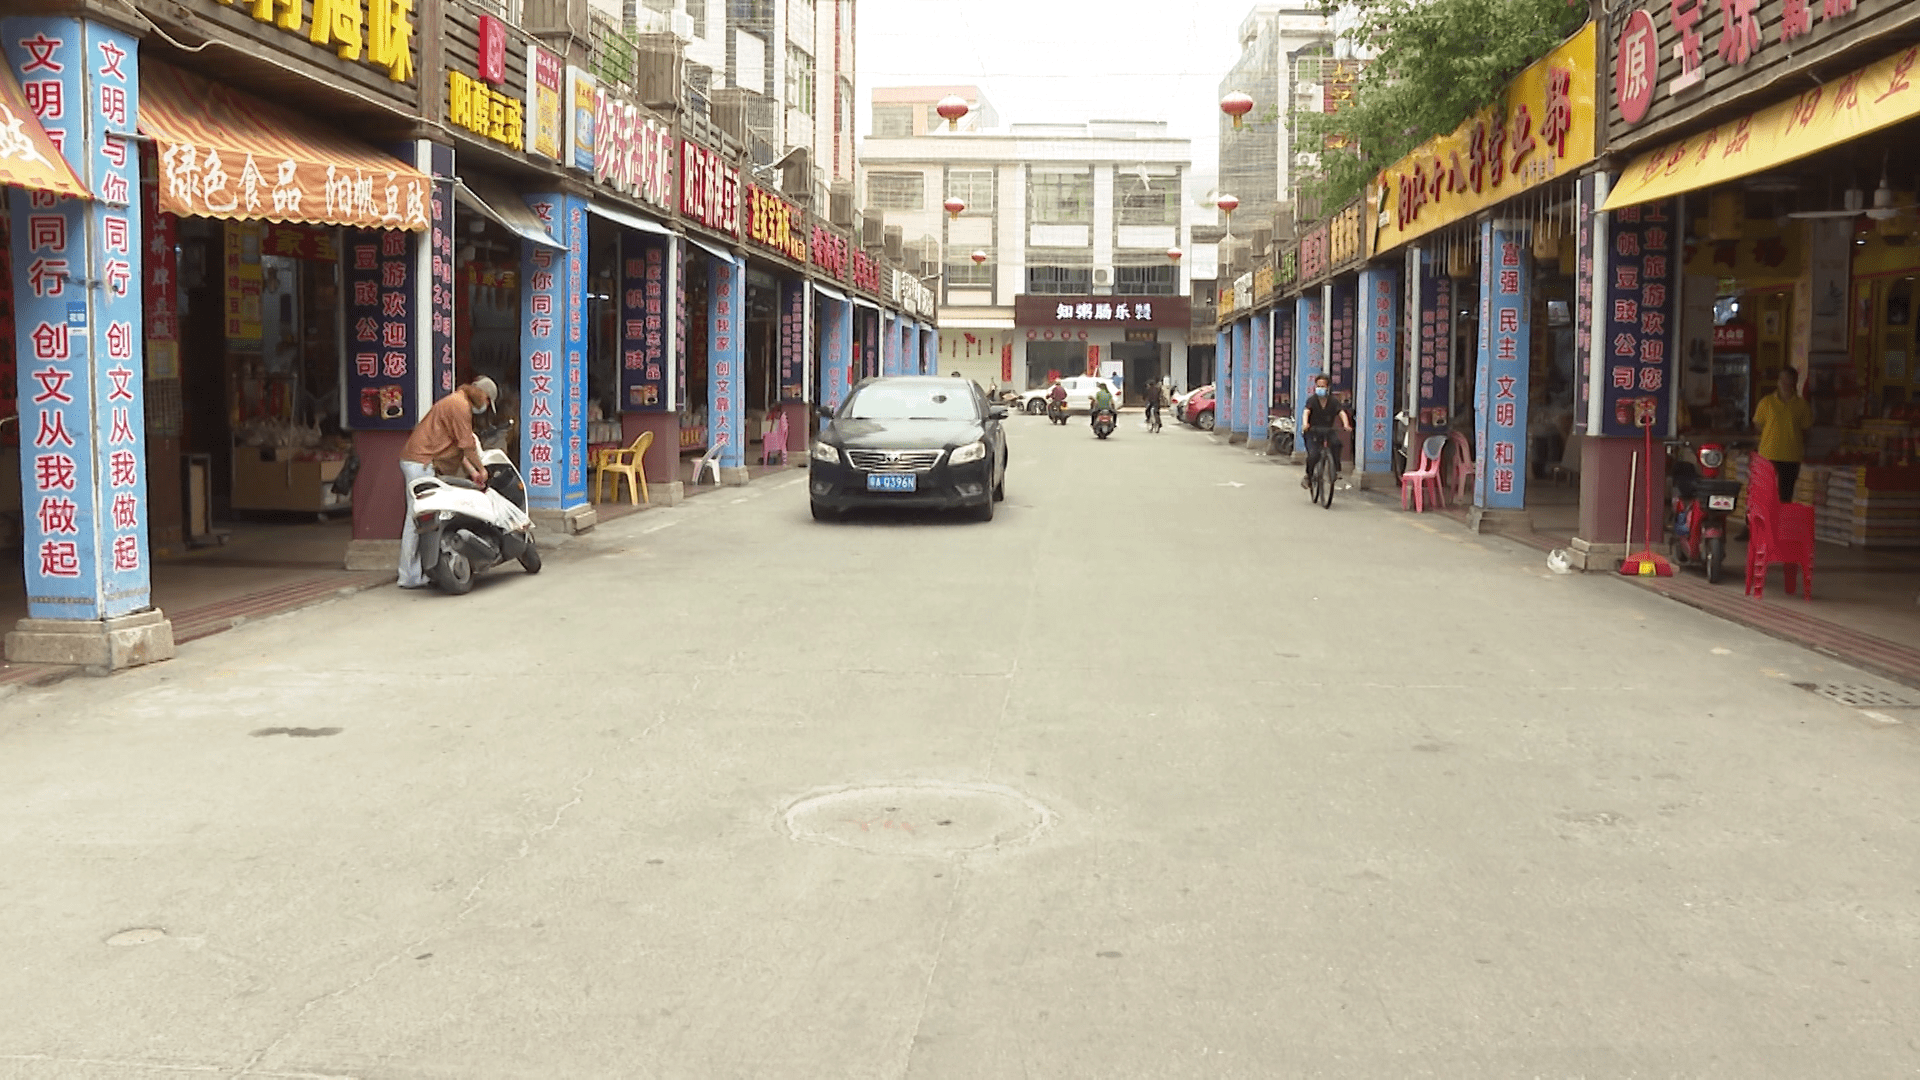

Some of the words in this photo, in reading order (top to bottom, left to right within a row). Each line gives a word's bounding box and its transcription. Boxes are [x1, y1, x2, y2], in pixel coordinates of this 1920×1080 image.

[1623, 27, 1648, 101] 原
[99, 41, 130, 296] 文明与你同行
[164, 143, 302, 214] 绿色食品
[355, 228, 379, 377] 豆豉公司
[531, 203, 552, 337] 文与你同行
[1498, 308, 1518, 360] 民主
[1500, 242, 1520, 295] 富强
[1639, 203, 1667, 391] 工业旅游欢迎您
[32, 323, 80, 576] 创文从我做起
[107, 323, 138, 571] 创文从我做起
[530, 351, 551, 486] 创文从我做起
[1496, 375, 1516, 426] 文明
[1494, 442, 1514, 494] 和谐
